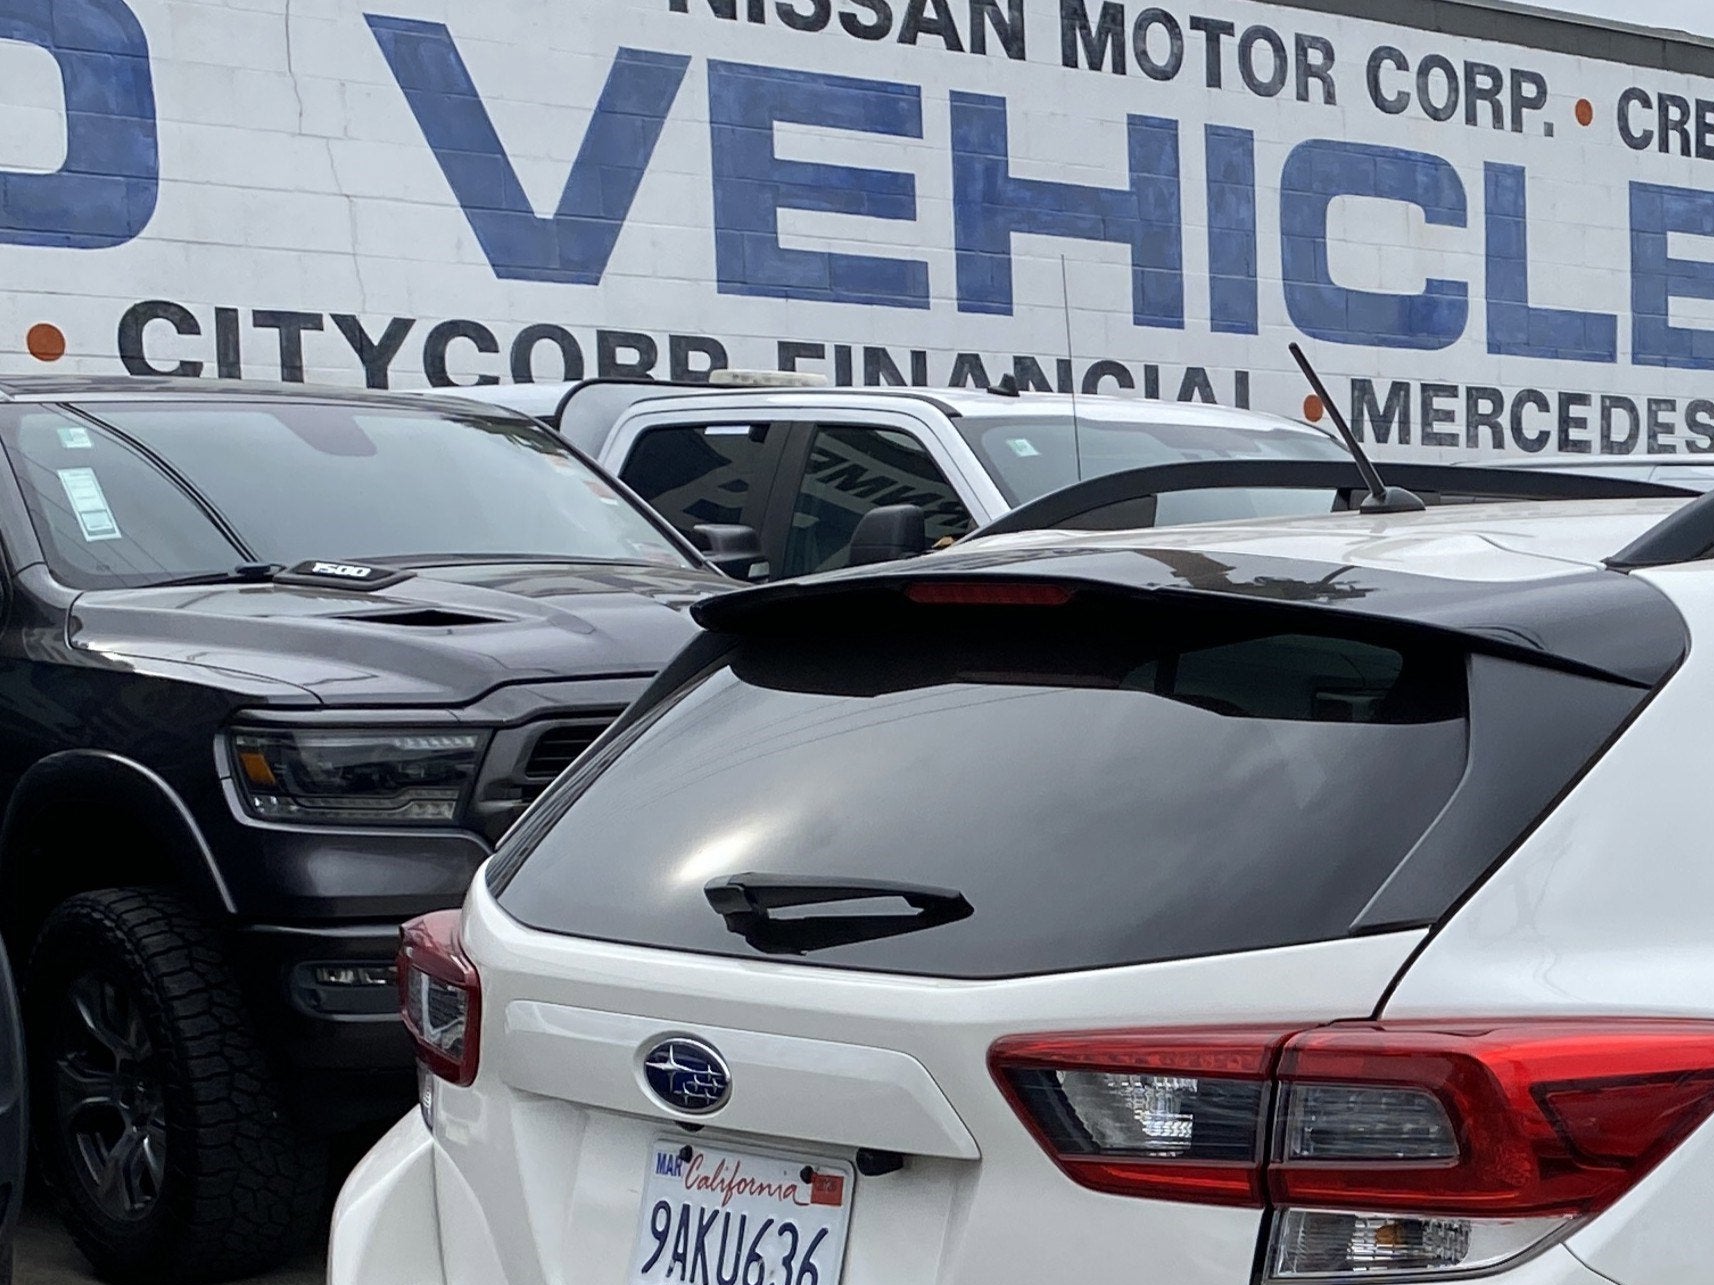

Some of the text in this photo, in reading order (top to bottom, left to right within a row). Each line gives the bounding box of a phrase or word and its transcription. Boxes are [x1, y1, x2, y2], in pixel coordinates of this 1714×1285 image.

[670, 0, 1026, 61] SAN
[1061, 0, 1338, 106] MOTOR
[1366, 45, 1555, 138] CORP.
[117, 300, 729, 390] CITYCORP
[312, 562, 372, 577] 1500
[655, 1152, 683, 1177] MAR
[684, 1153, 811, 1208] California
